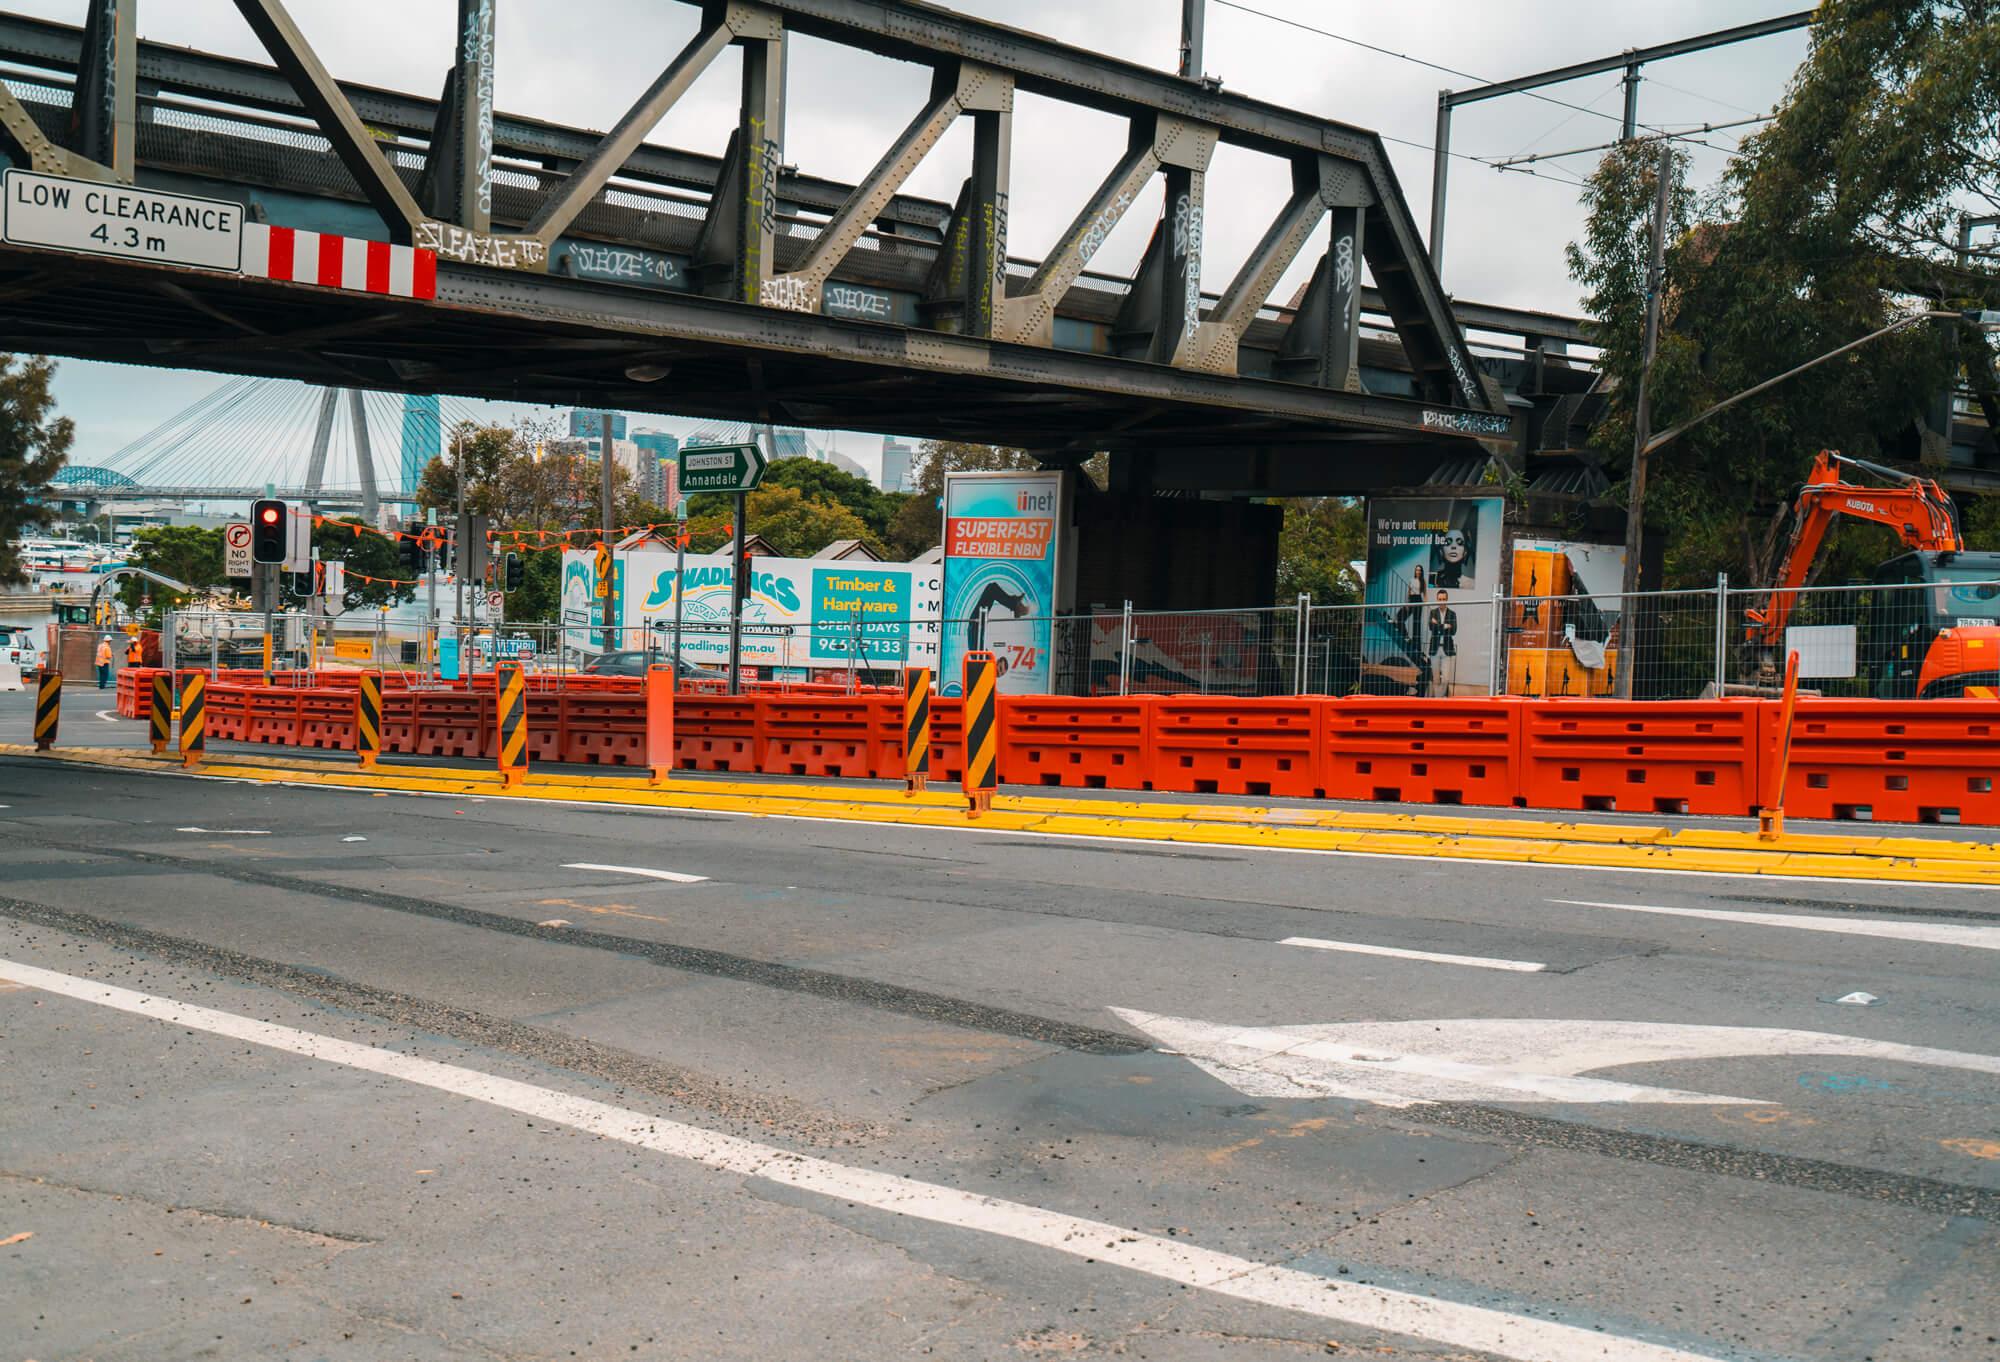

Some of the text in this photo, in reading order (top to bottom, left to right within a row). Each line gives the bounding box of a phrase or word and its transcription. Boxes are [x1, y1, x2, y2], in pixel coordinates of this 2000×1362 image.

[17, 181, 232, 233] LOW CLEARANCE
[90, 223, 166, 252] 4.3 m
[688, 456, 733, 466] JOHNSTON ST
[684, 472, 737, 487] Annandale
[1017, 489, 1054, 512] iinet
[1846, 498, 1875, 513] KUBOTA
[955, 520, 1048, 539] SUPERFAST
[1377, 518, 1449, 533] We're not moving
[1377, 533, 1391, 545] but
[1392, 535, 1408, 547] you
[1409, 533, 1433, 545] could
[231, 550, 247, 559] NO
[955, 542, 1042, 556] FLEXIBLE NBN
[826, 577, 896, 592] Timber &
[823, 597, 898, 612] Hardware
[867, 623, 900, 633] DAYS
